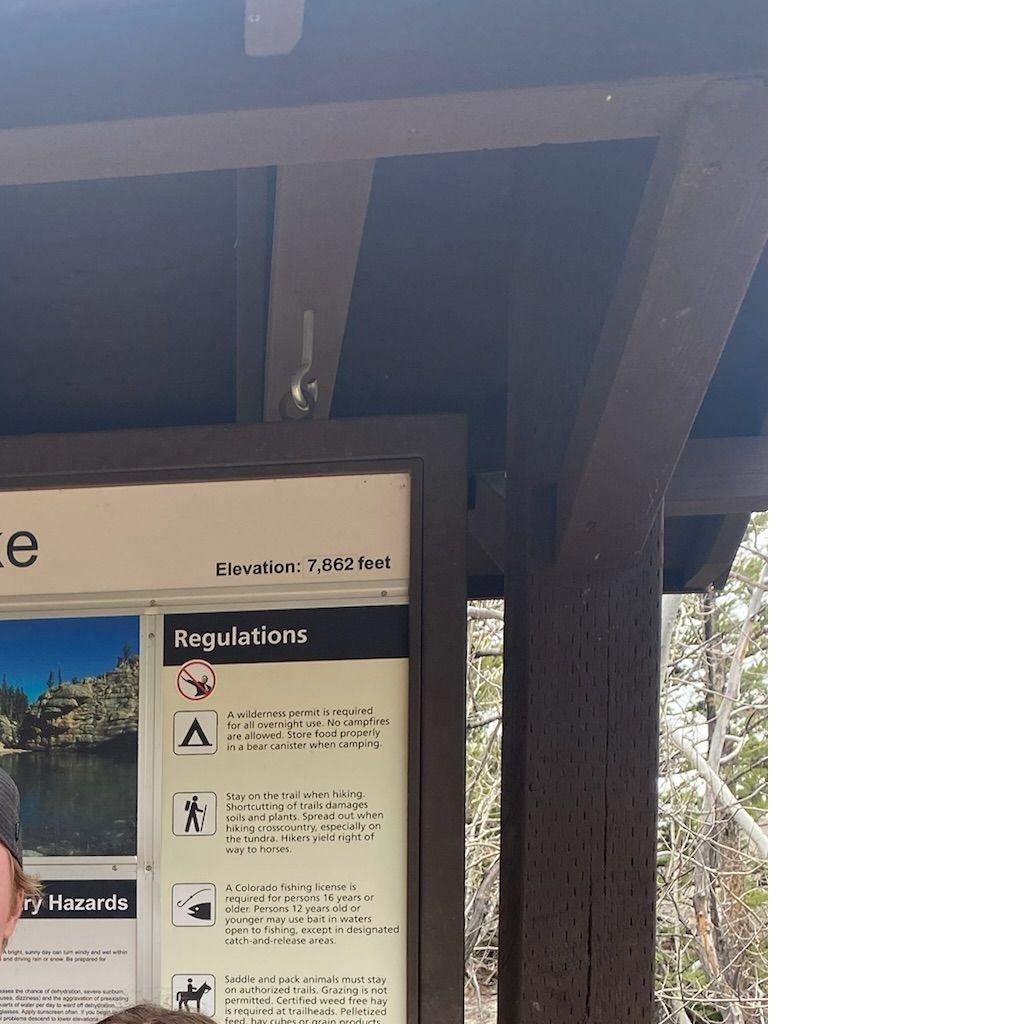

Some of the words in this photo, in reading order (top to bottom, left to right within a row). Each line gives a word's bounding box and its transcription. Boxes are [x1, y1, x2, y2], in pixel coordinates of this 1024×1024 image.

[216, 559, 300, 576] Elevation:
[307, 557, 353, 574] 7,862
[357, 555, 391, 570] feet
[174, 624, 307, 652] Regulations
[236, 709, 286, 718] wilderness
[288, 708, 319, 718] permit
[323, 708, 329, 716] is
[332, 707, 372, 719] required
[226, 720, 240, 729] for
[243, 720, 254, 729] all
[257, 719, 303, 730] overnight
[327, 718, 340, 726] No
[343, 717, 390, 729] campfires
[244, 730, 284, 740] allowed.
[287, 730, 312, 738] Store
[314, 729, 337, 738] food
[340, 729, 380, 740] properly
[246, 742, 268, 750] bear
[269, 742, 307, 750] canister
[308, 740, 336, 749] when
[338, 740, 382, 749] camping.
[224, 883, 232, 891] A
[234, 883, 278, 892] Colorado
[280, 882, 312, 893] fishing
[315, 882, 346, 891] license
[48, 893, 128, 910] Hazards
[225, 894, 264, 904] required
[268, 893, 281, 902] for
[284, 895, 319, 903] persons
[324, 893, 333, 901] 16
[336, 894, 361, 903] years
[224, 904, 250, 913] older.
[253, 904, 289, 913] Persons
[292, 904, 302, 912] 12
[305, 905, 329, 914] years
[332, 903, 347, 912] old
[224, 917, 264, 925] younger
[266, 916, 286, 925] may
[306, 914, 325, 923] bait
[328, 914, 337, 922] in
[339, 915, 371, 923] waters
[224, 927, 248, 935] open
[251, 926, 261, 934] to
[263, 925, 298, 936] fishing,
[301, 926, 332, 935] except
[334, 925, 343, 933] in
[346, 924, 399, 935] designated
[224, 936, 306, 944] catch-and-release
